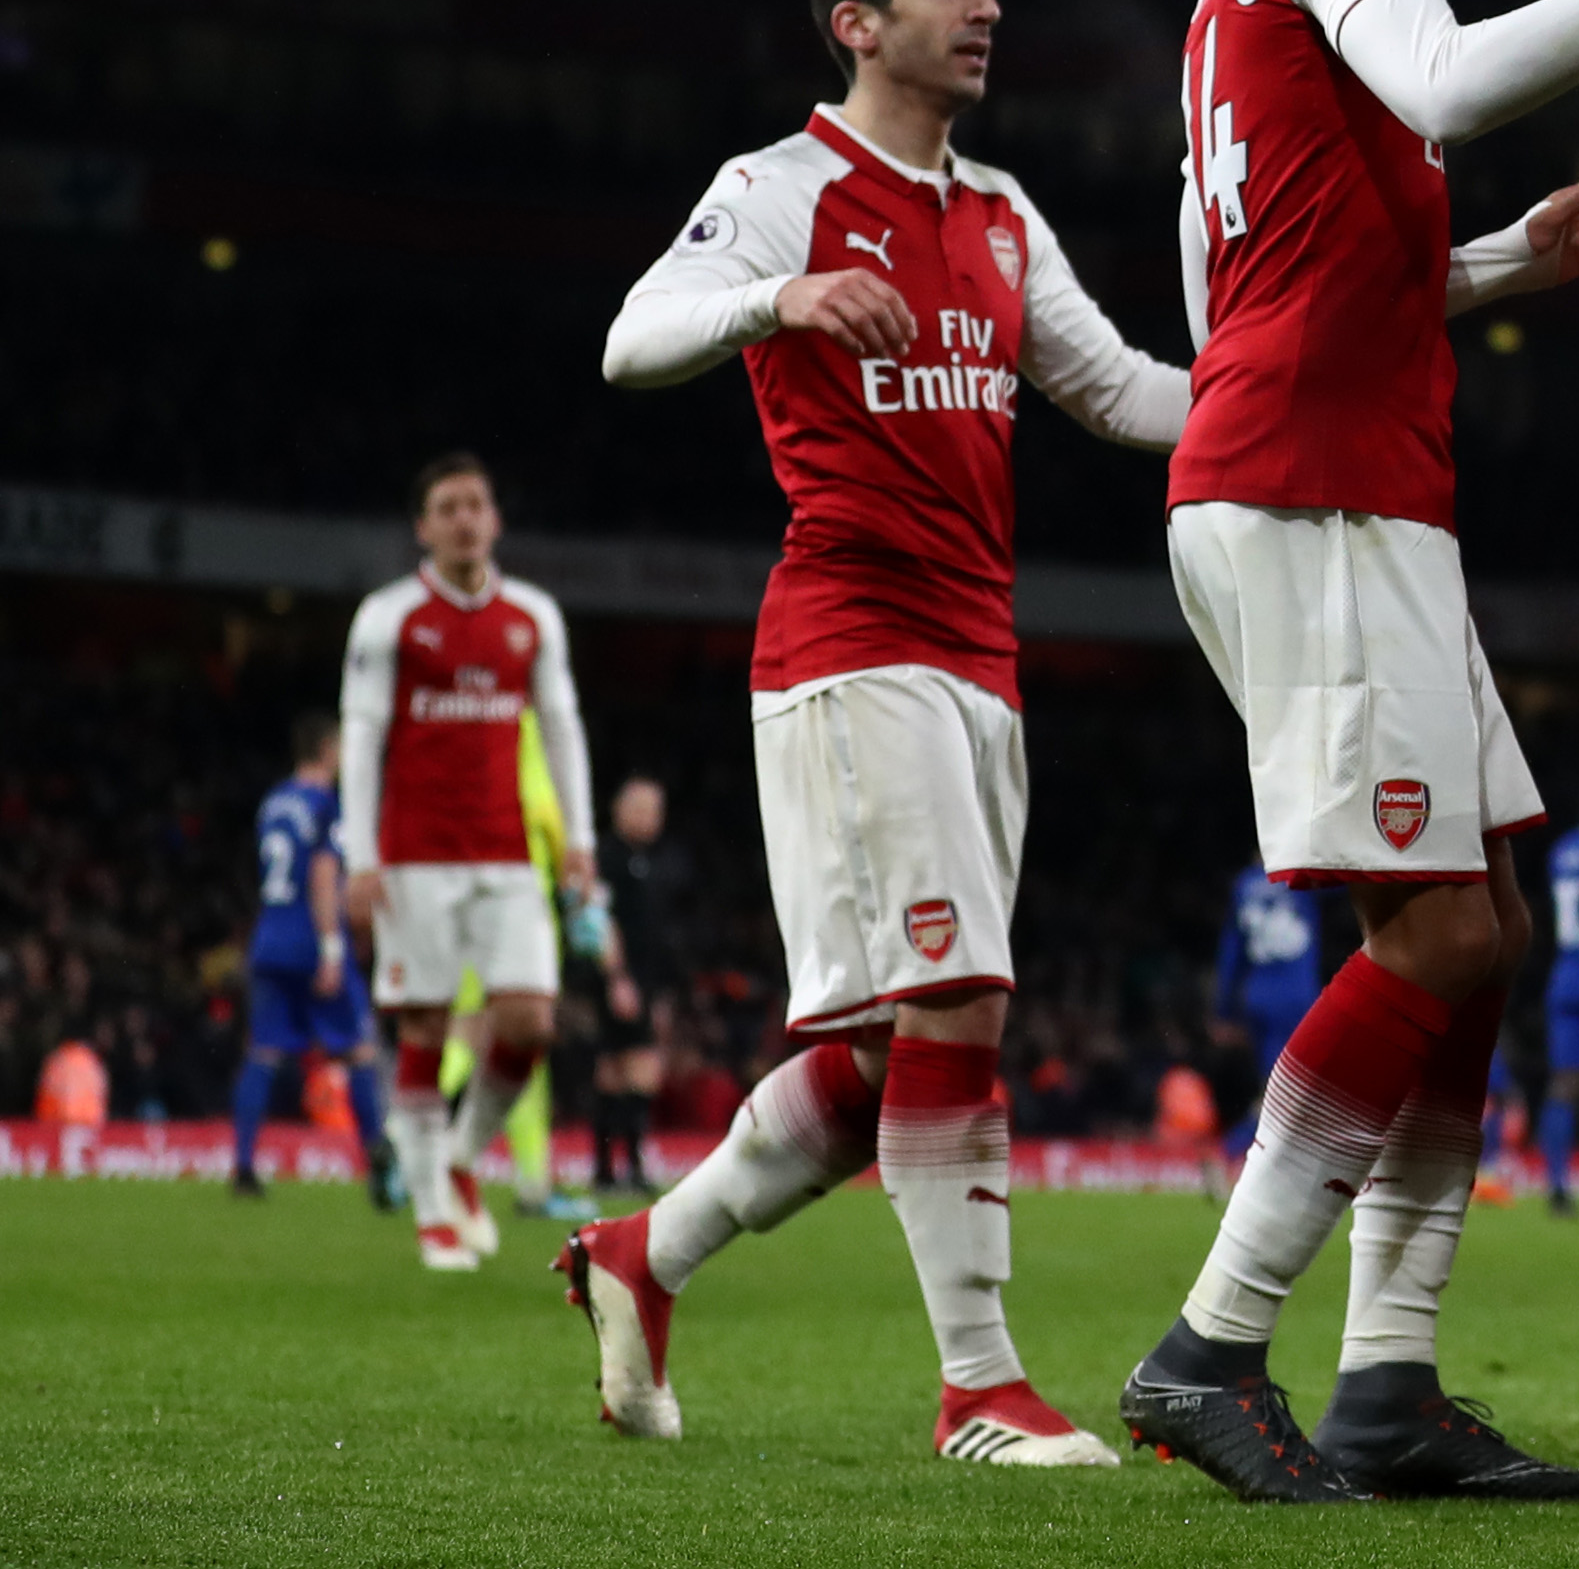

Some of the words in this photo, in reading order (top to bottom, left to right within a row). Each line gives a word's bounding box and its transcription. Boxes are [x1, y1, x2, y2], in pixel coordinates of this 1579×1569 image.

[937, 308, 995, 359] Fly
[857, 351, 1020, 421] Emirate
[1379, 790, 1423, 803] Arsenal
